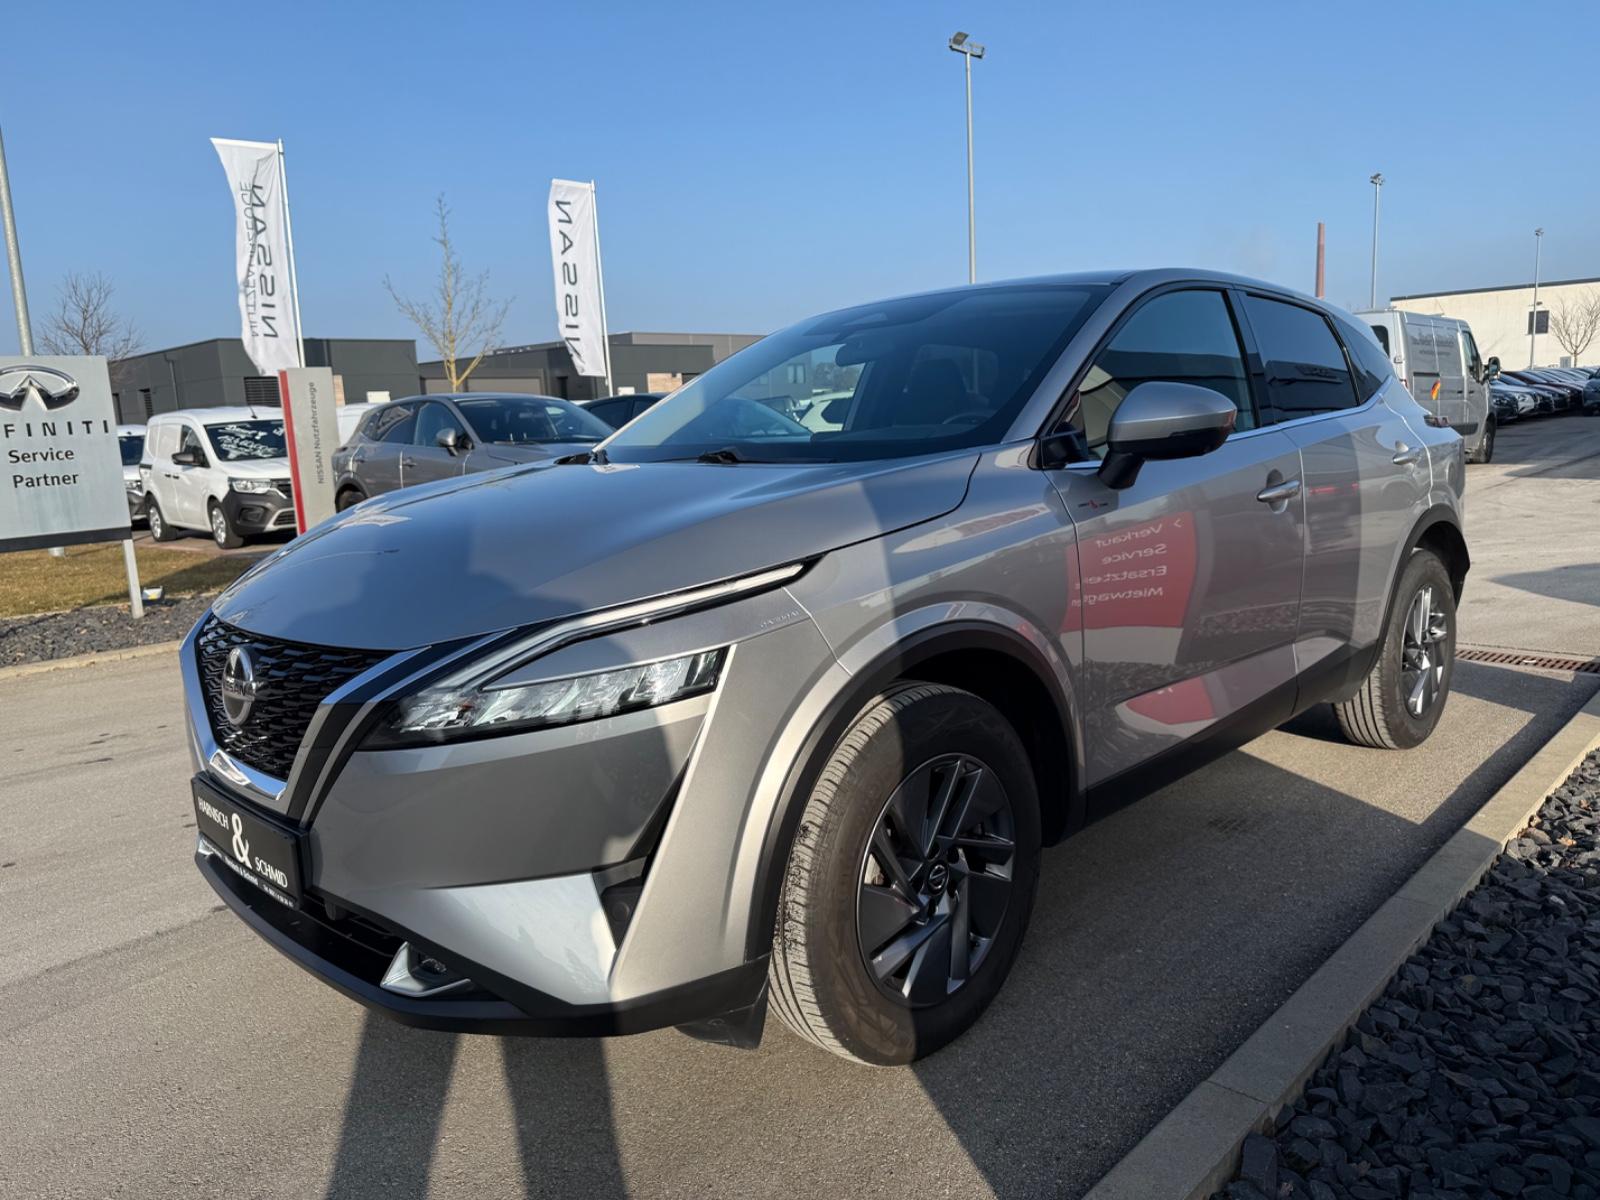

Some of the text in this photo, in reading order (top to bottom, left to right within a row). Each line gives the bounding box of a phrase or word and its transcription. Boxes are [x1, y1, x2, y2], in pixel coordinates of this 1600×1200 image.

[8, 447, 75, 464] Service
[12, 473, 79, 489] Partner
[231, 813, 253, 870] &
[255, 856, 288, 888] SCHMID
